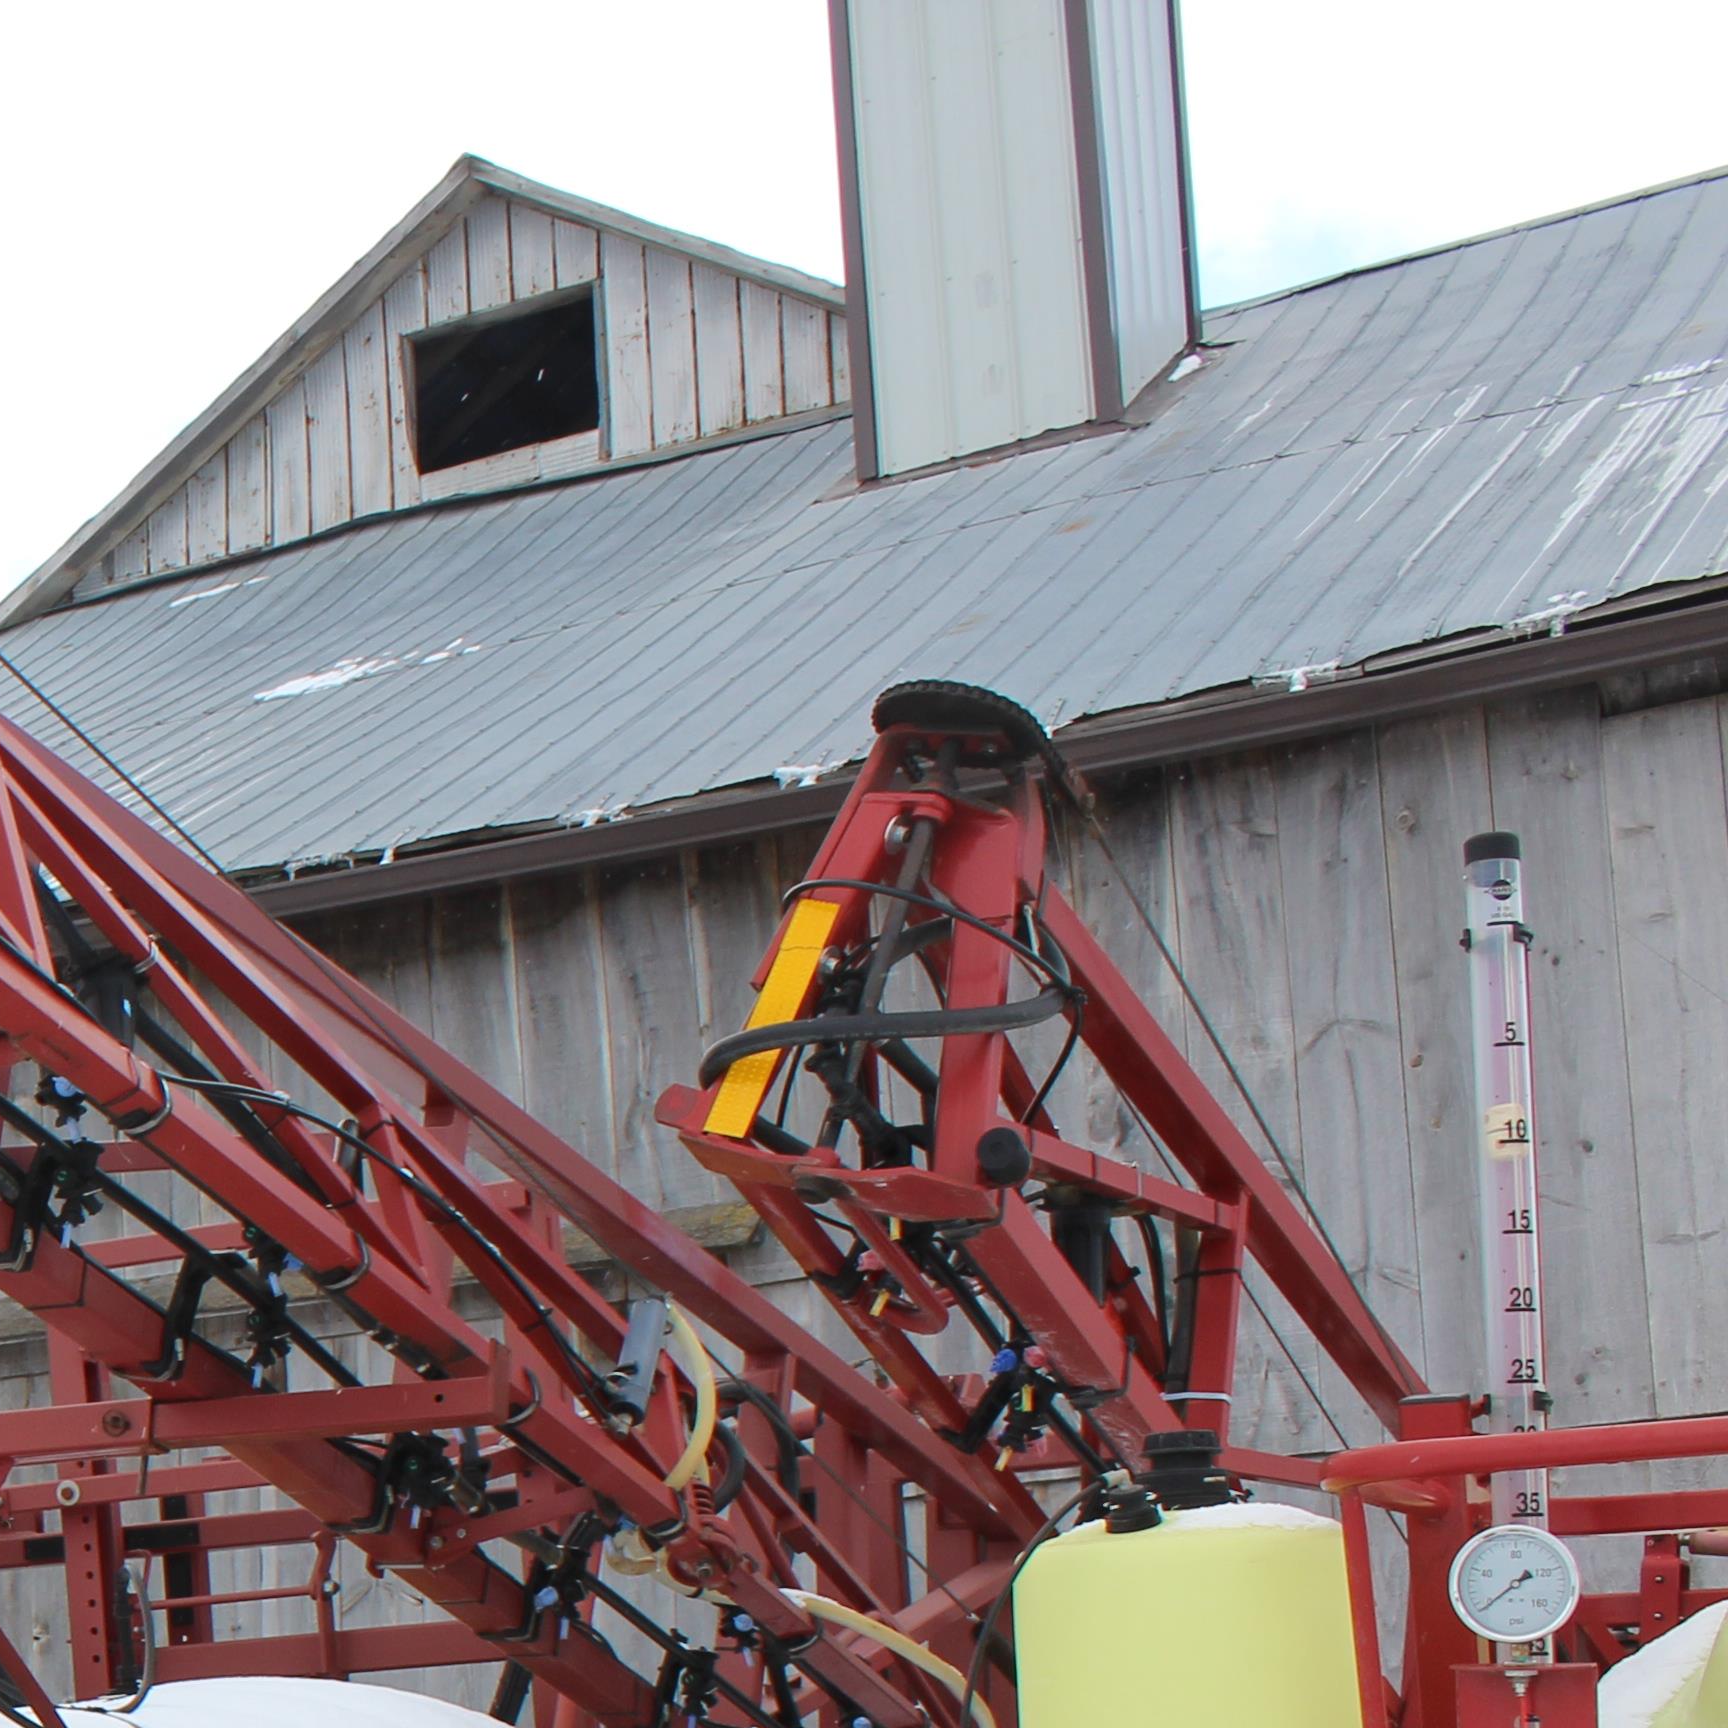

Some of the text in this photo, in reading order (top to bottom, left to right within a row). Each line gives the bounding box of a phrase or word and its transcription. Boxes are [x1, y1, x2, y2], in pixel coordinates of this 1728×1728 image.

[1505, 1021, 1516, 1041] 5
[1504, 1119, 1527, 1139] 10
[1507, 1209, 1530, 1230] 15
[1510, 1287, 1533, 1307] 20
[1511, 1358, 1535, 1379] 25
[1516, 1492, 1540, 1512] 35
[1510, 1550, 1522, 1559] 80
[1482, 1569, 1493, 1578] 40
[1535, 1568, 1552, 1577] 120
[1531, 1599, 1548, 1607] 160
[1509, 1618, 1524, 1626] psi
